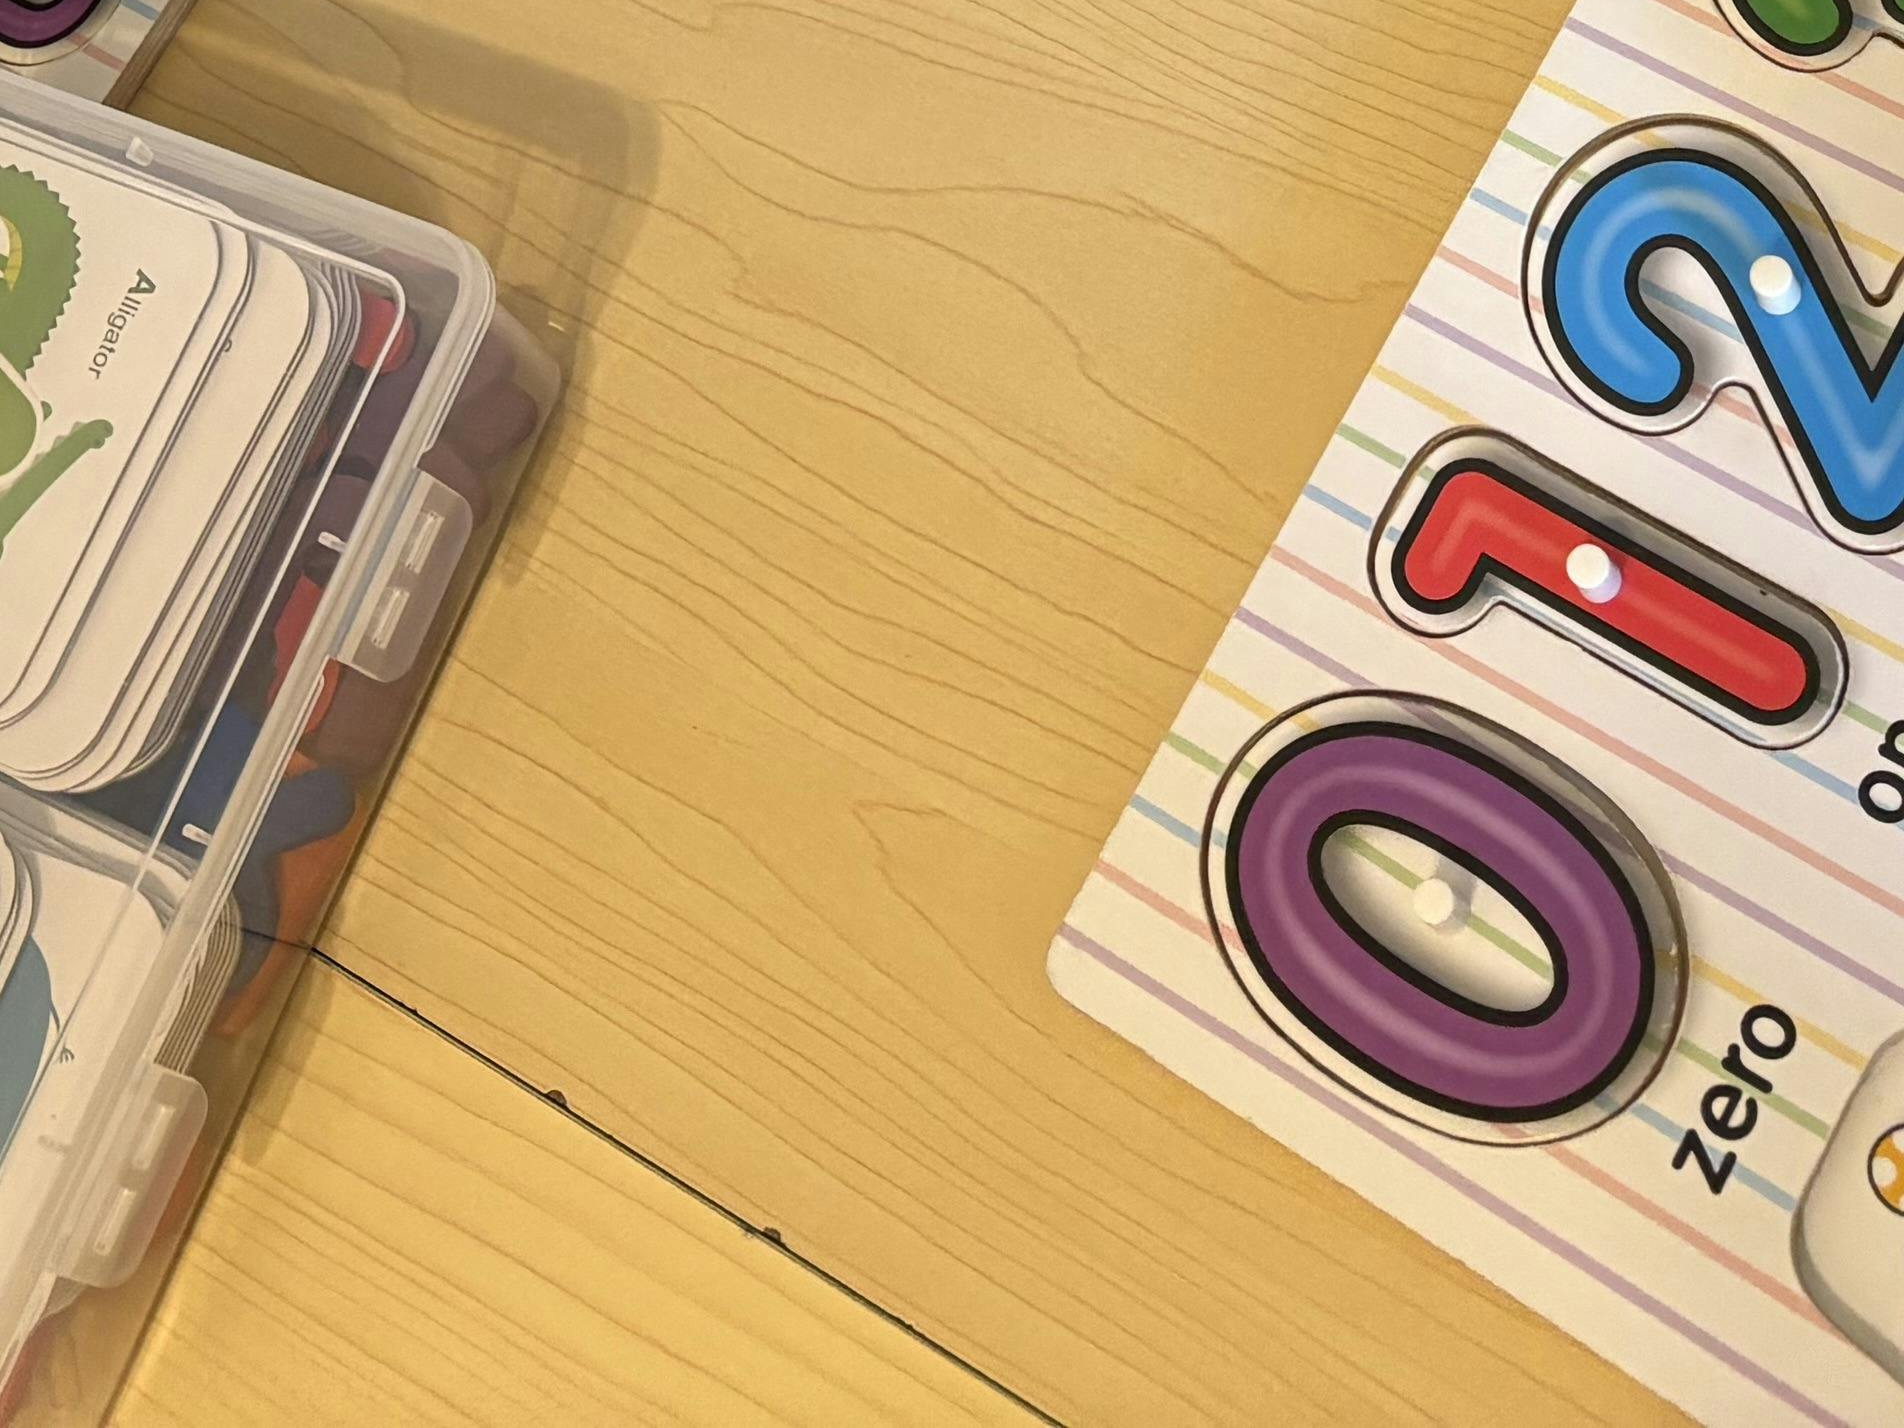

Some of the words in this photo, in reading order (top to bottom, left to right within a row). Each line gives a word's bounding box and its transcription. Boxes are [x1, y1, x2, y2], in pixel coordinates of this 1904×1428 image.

[88, 269, 157, 380] Alligator
[1391, 453, 1821, 727] 1
[1226, 719, 1655, 1122] 0
[1673, 1000, 1798, 1196] zero
